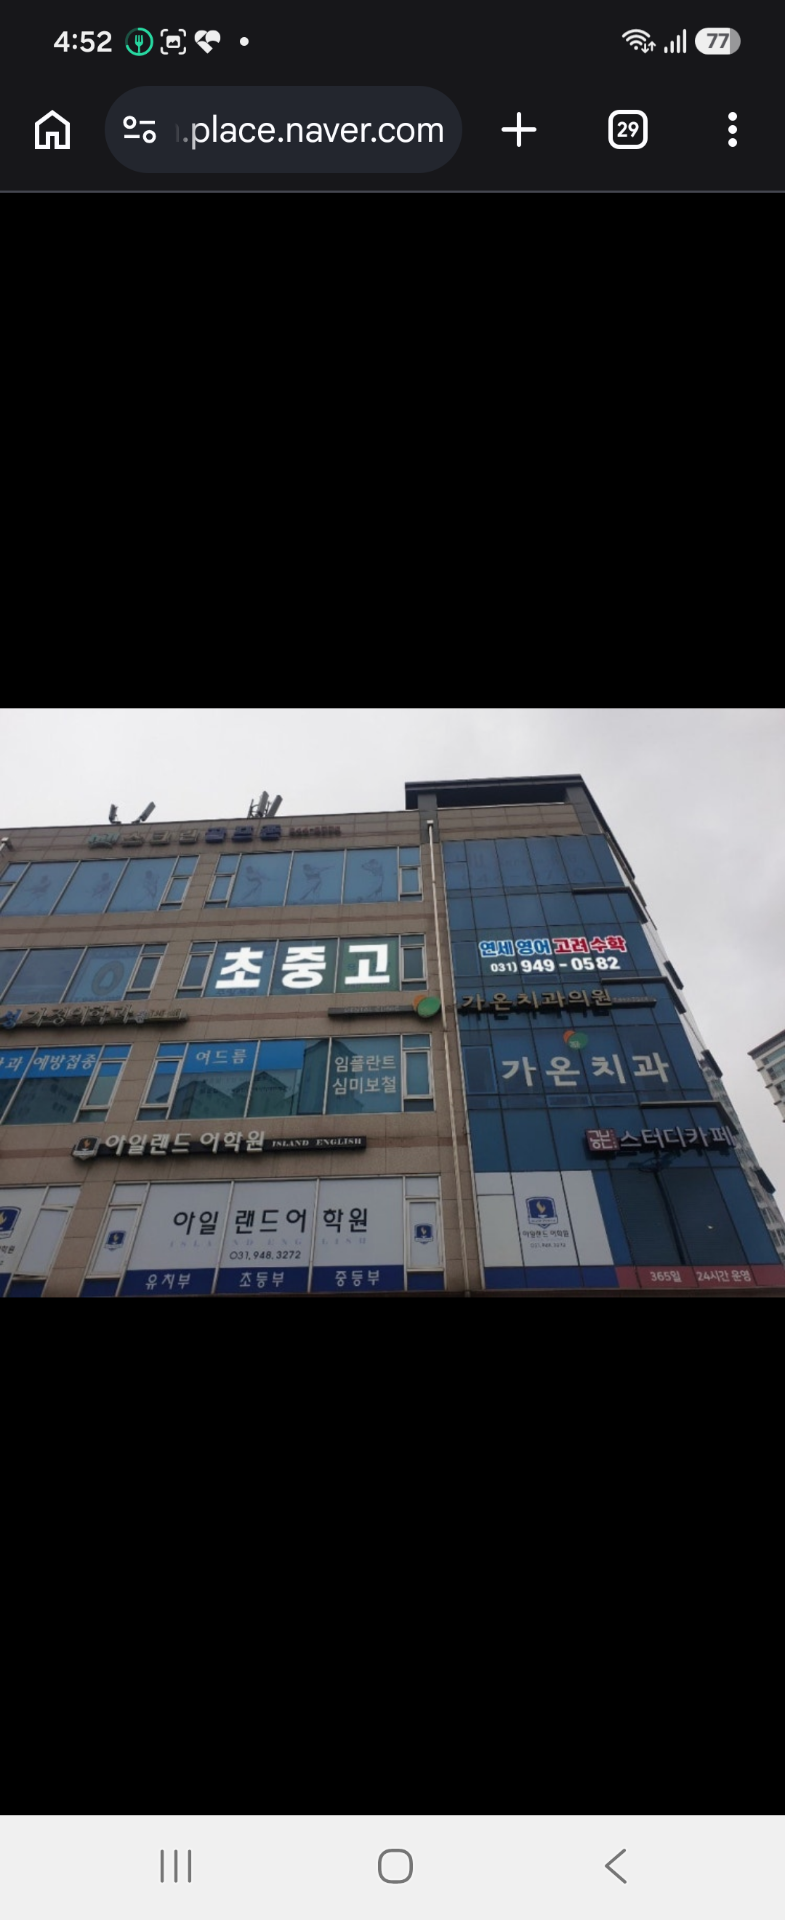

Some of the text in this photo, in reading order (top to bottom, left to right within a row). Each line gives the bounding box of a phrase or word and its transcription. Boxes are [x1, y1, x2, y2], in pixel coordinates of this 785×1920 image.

[53, 31, 112, 54] 4:52
[706, 32, 730, 50] 77
[616, 121, 639, 138] 29
[479, 935, 628, 958] 연세 영어 고려 수학
[490, 962, 518, 973] 031)
[462, 988, 613, 1012] 가온치과의원
[33, 1053, 97, 1071] 예방접종
[334, 1055, 397, 1073] 임플란트
[502, 1052, 670, 1087] 가온치과
[332, 1076, 397, 1095] 심미보철
[105, 1130, 265, 1156] 아일랜드 어학원
[271, 1137, 362, 1147] ISLAND ENGLISH
[620, 1126, 736, 1149] 스터디카페
[145, 1273, 191, 1291] 유치부
[239, 1272, 285, 1288] 초등부
[334, 1270, 380, 1287] 중등부
[650, 1269, 752, 1283] 365일 24시간 운영
